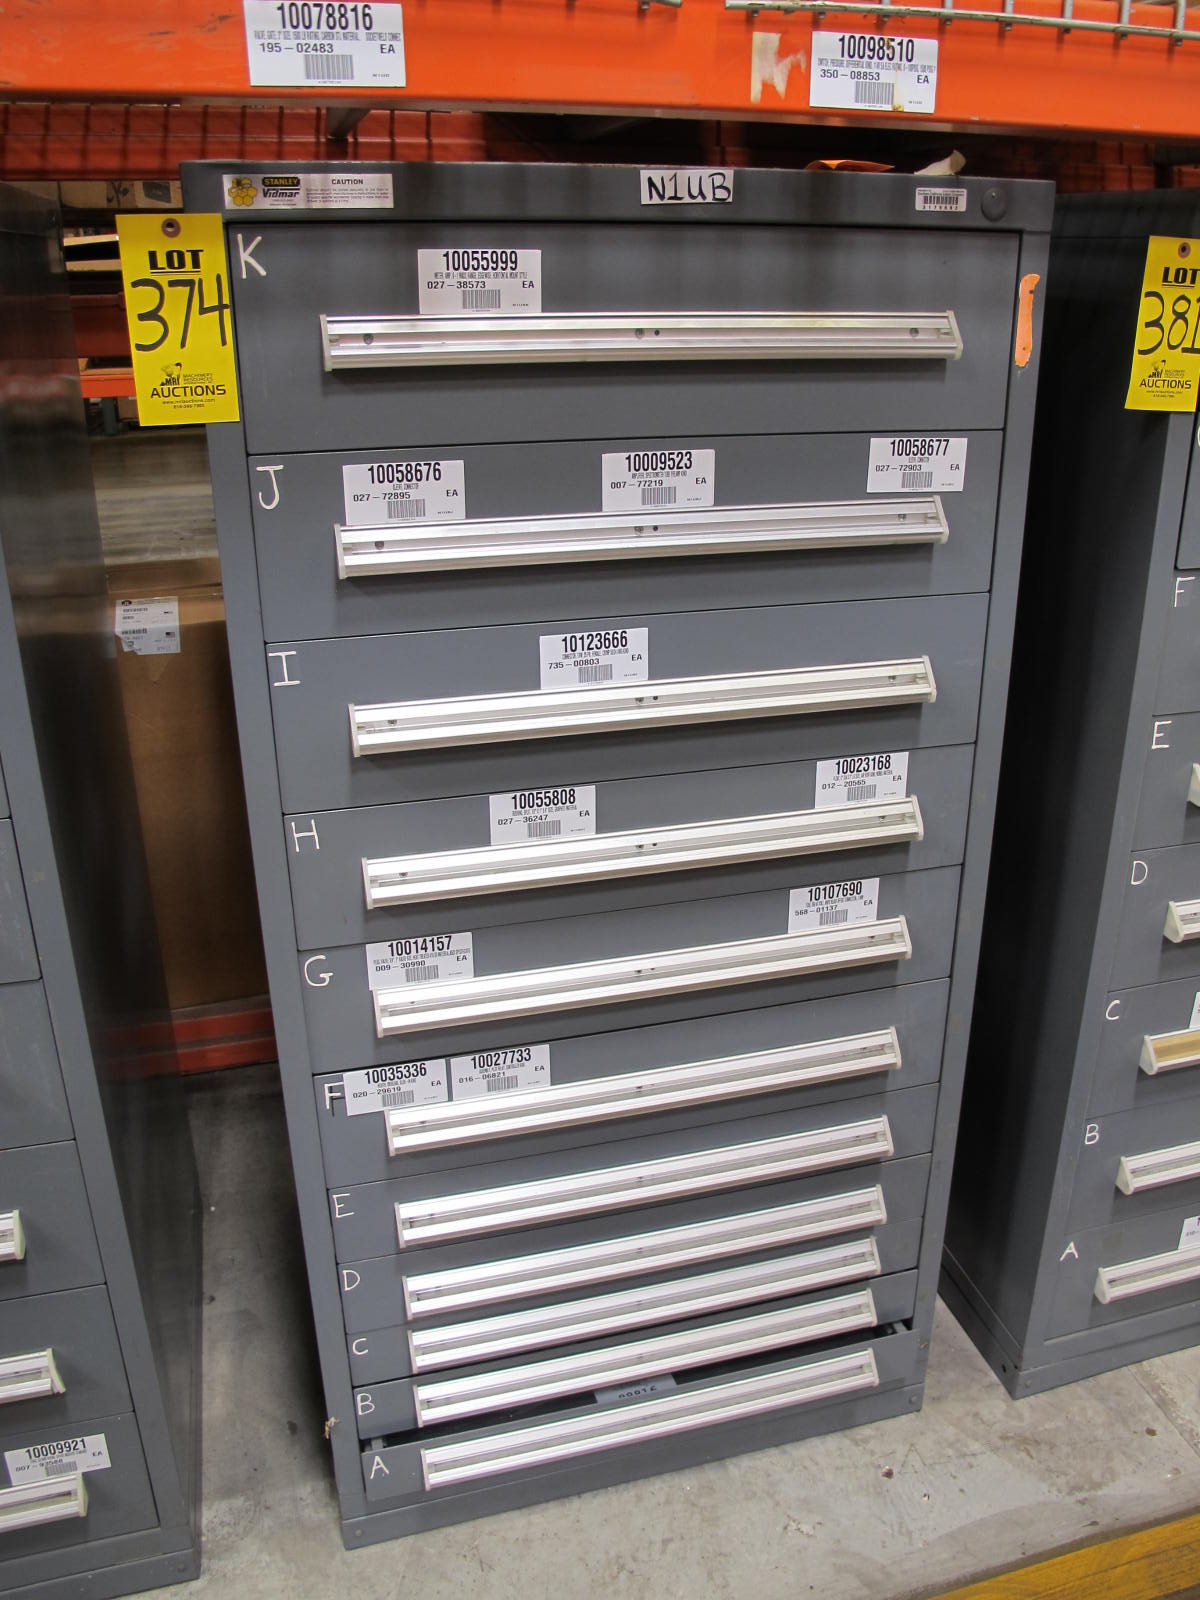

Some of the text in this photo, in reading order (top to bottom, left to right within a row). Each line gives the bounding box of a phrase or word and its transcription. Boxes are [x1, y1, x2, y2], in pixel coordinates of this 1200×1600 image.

[277, 2, 373, 30] 10078816
[380, 44, 396, 54] EA
[838, 35, 914, 62] 10098510
[916, 75, 930, 84] EA
[263, 178, 299, 186] STANLEY
[262, 188, 300, 199] Vidmar
[148, 249, 204, 271] LOT
[237, 233, 267, 280] K
[443, 250, 518, 271] 10055999
[522, 280, 535, 289] EA
[1161, 266, 1200, 285] LOT
[131, 273, 230, 352] 374
[151, 385, 226, 398] AUCTIONS
[1139, 379, 1192, 389] AUCTIONS
[890, 439, 950, 457] 10058677
[625, 451, 693, 472] 10009523
[950, 463, 960, 471] EA
[368, 462, 442, 484] 10058676
[695, 477, 707, 485] EA
[256, 464, 284, 510] J
[446, 489, 459, 497] EA
[1174, 576, 1196, 607] F
[562, 630, 628, 653] 10123666
[268, 651, 301, 687] I
[1151, 720, 1172, 749] E
[836, 754, 891, 775] 10023168
[512, 788, 576, 810] 10055808
[291, 819, 320, 852] H
[1131, 860, 1148, 885] D
[808, 881, 863, 902] 10107690
[388, 935, 452, 957] 10014157
[304, 954, 334, 987] G
[1105, 1000, 1120, 1020] C
[470, 1047, 532, 1069] 10027733
[365, 1062, 427, 1084] 10035336
[324, 1082, 344, 1110] F
[1084, 1123, 1099, 1145] B
[332, 1193, 355, 1218] E
[1059, 1241, 1078, 1262] A
[343, 1269, 361, 1291] D
[352, 1337, 369, 1355] C
[356, 1393, 375, 1416] B
[25, 1438, 87, 1460] 10009921
[370, 1455, 390, 1479] A
